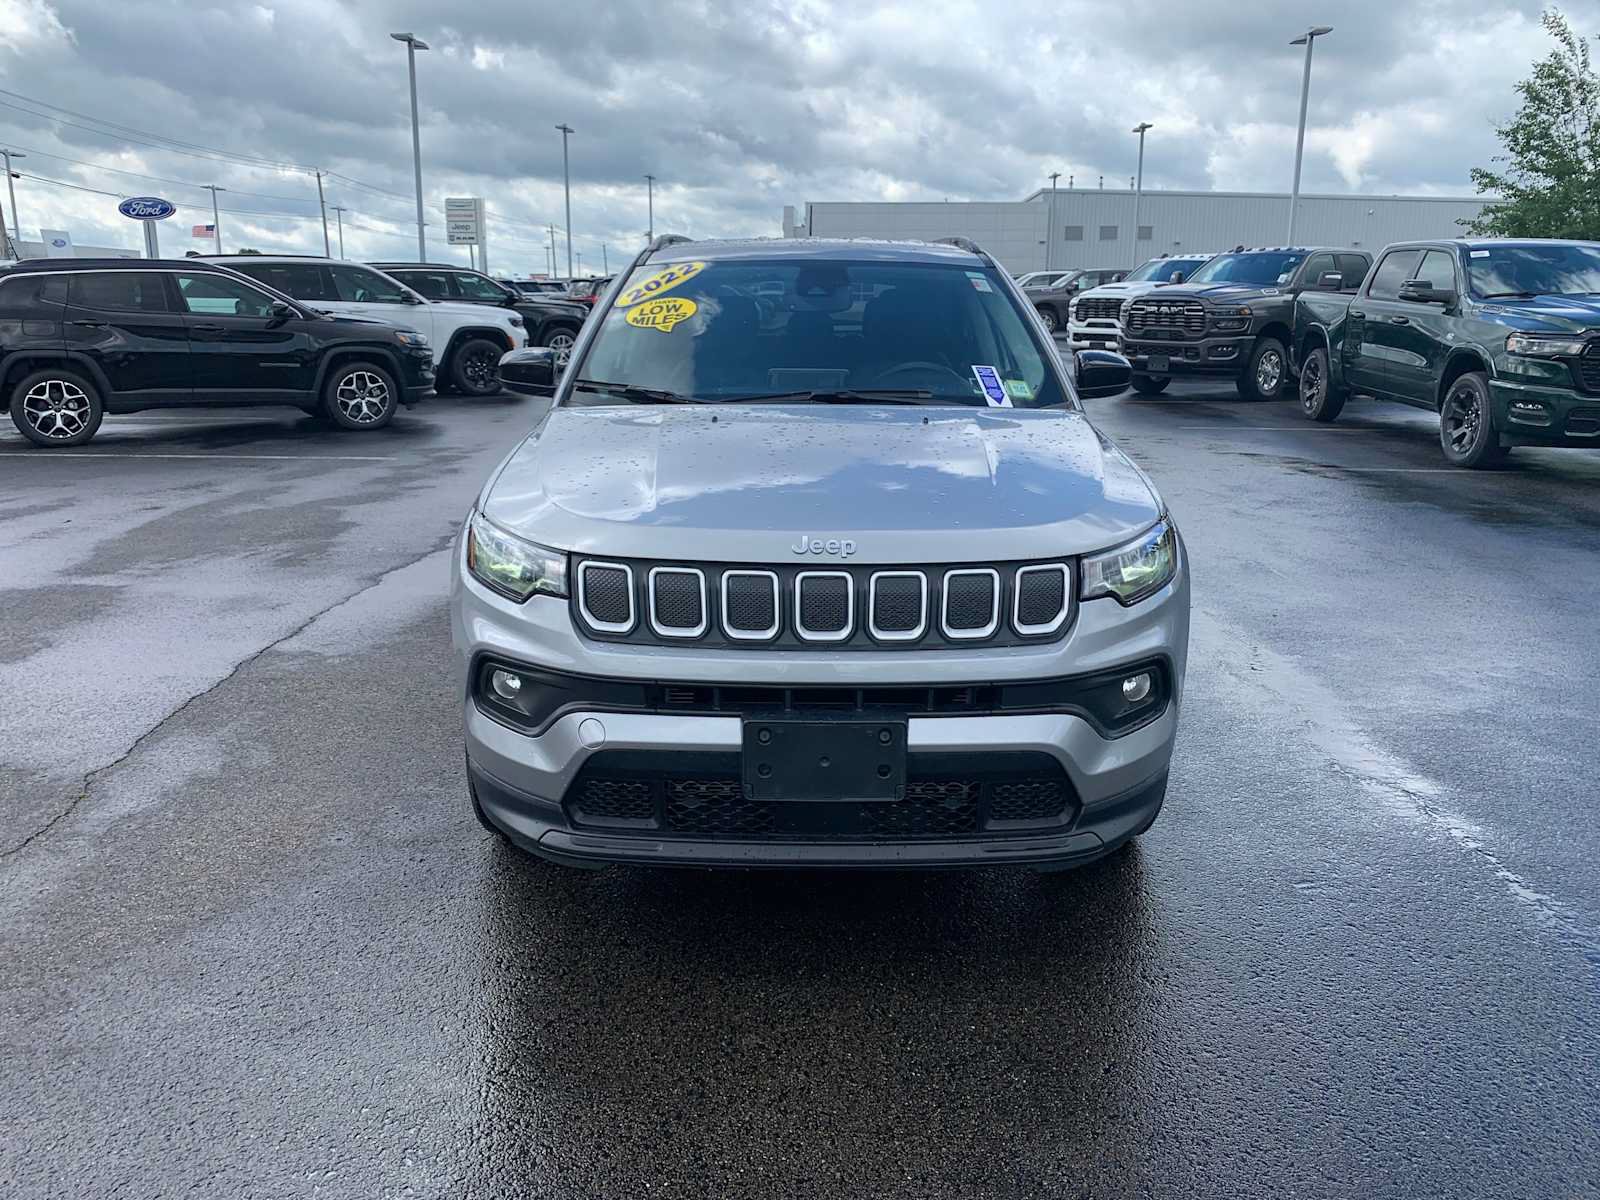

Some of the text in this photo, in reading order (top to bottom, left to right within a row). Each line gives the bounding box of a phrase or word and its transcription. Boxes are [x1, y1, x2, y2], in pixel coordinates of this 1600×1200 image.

[130, 201, 161, 215] Ford
[451, 223, 471, 231] Jeep
[628, 264, 699, 303] 2022
[639, 303, 683, 316] LOW
[1146, 306, 1184, 314] RAM
[632, 313, 687, 326] MILES
[791, 535, 857, 558] Jeep
